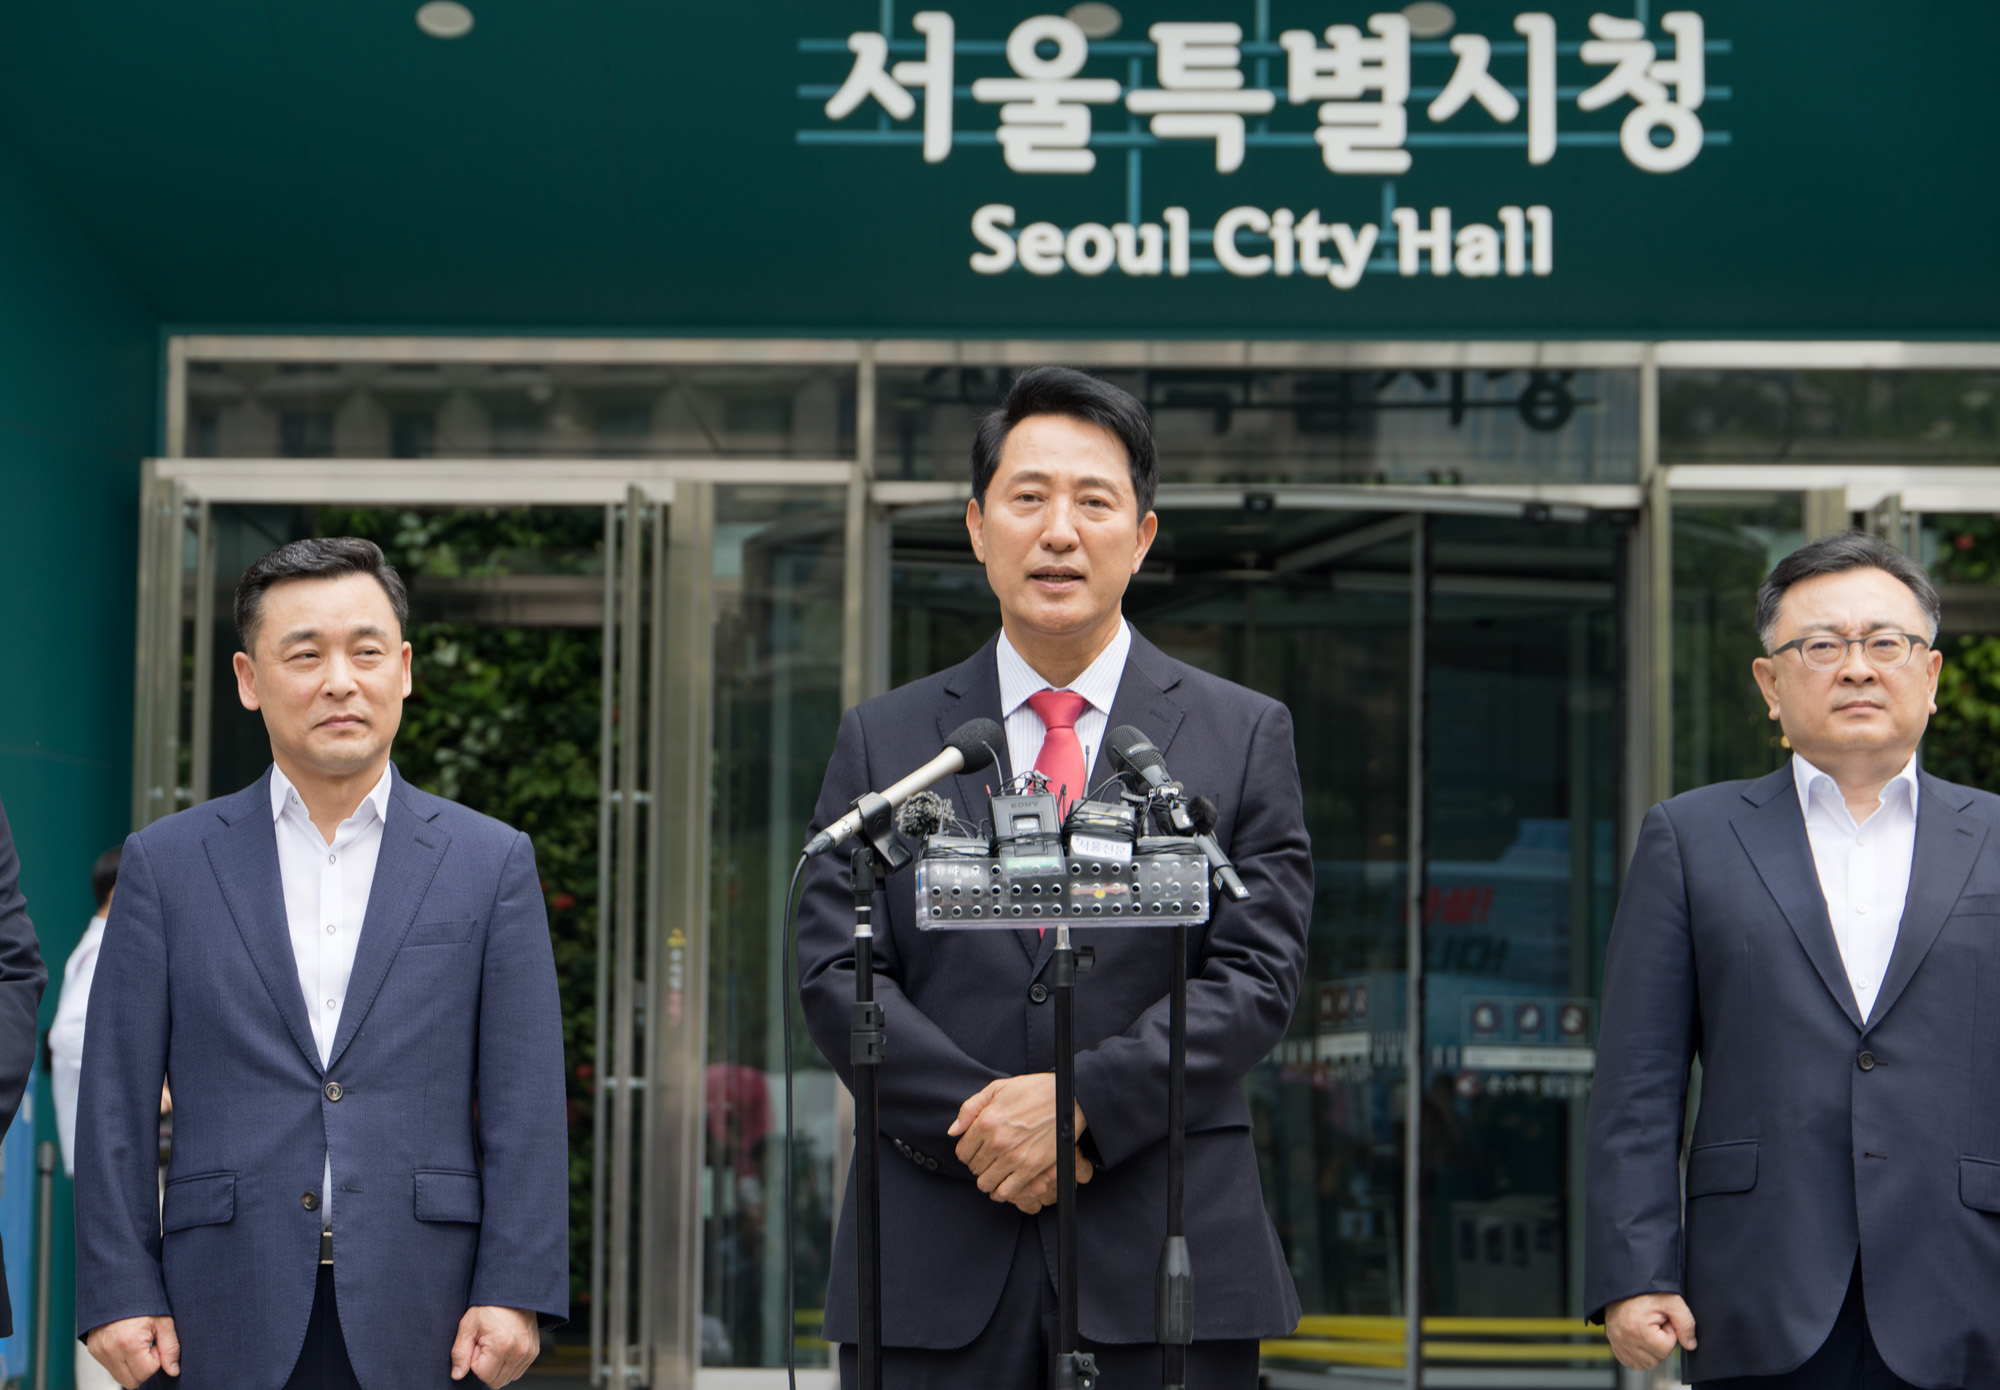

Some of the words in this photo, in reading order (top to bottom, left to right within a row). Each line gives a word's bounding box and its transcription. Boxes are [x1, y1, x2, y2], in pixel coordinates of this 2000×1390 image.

[824, 10, 1706, 174] 서울특별시청
[970, 204, 1190, 277] Seoul
[1212, 204, 1380, 289] City
[1389, 205, 1554, 277] Hall
[1010, 801, 1039, 809] SONY
